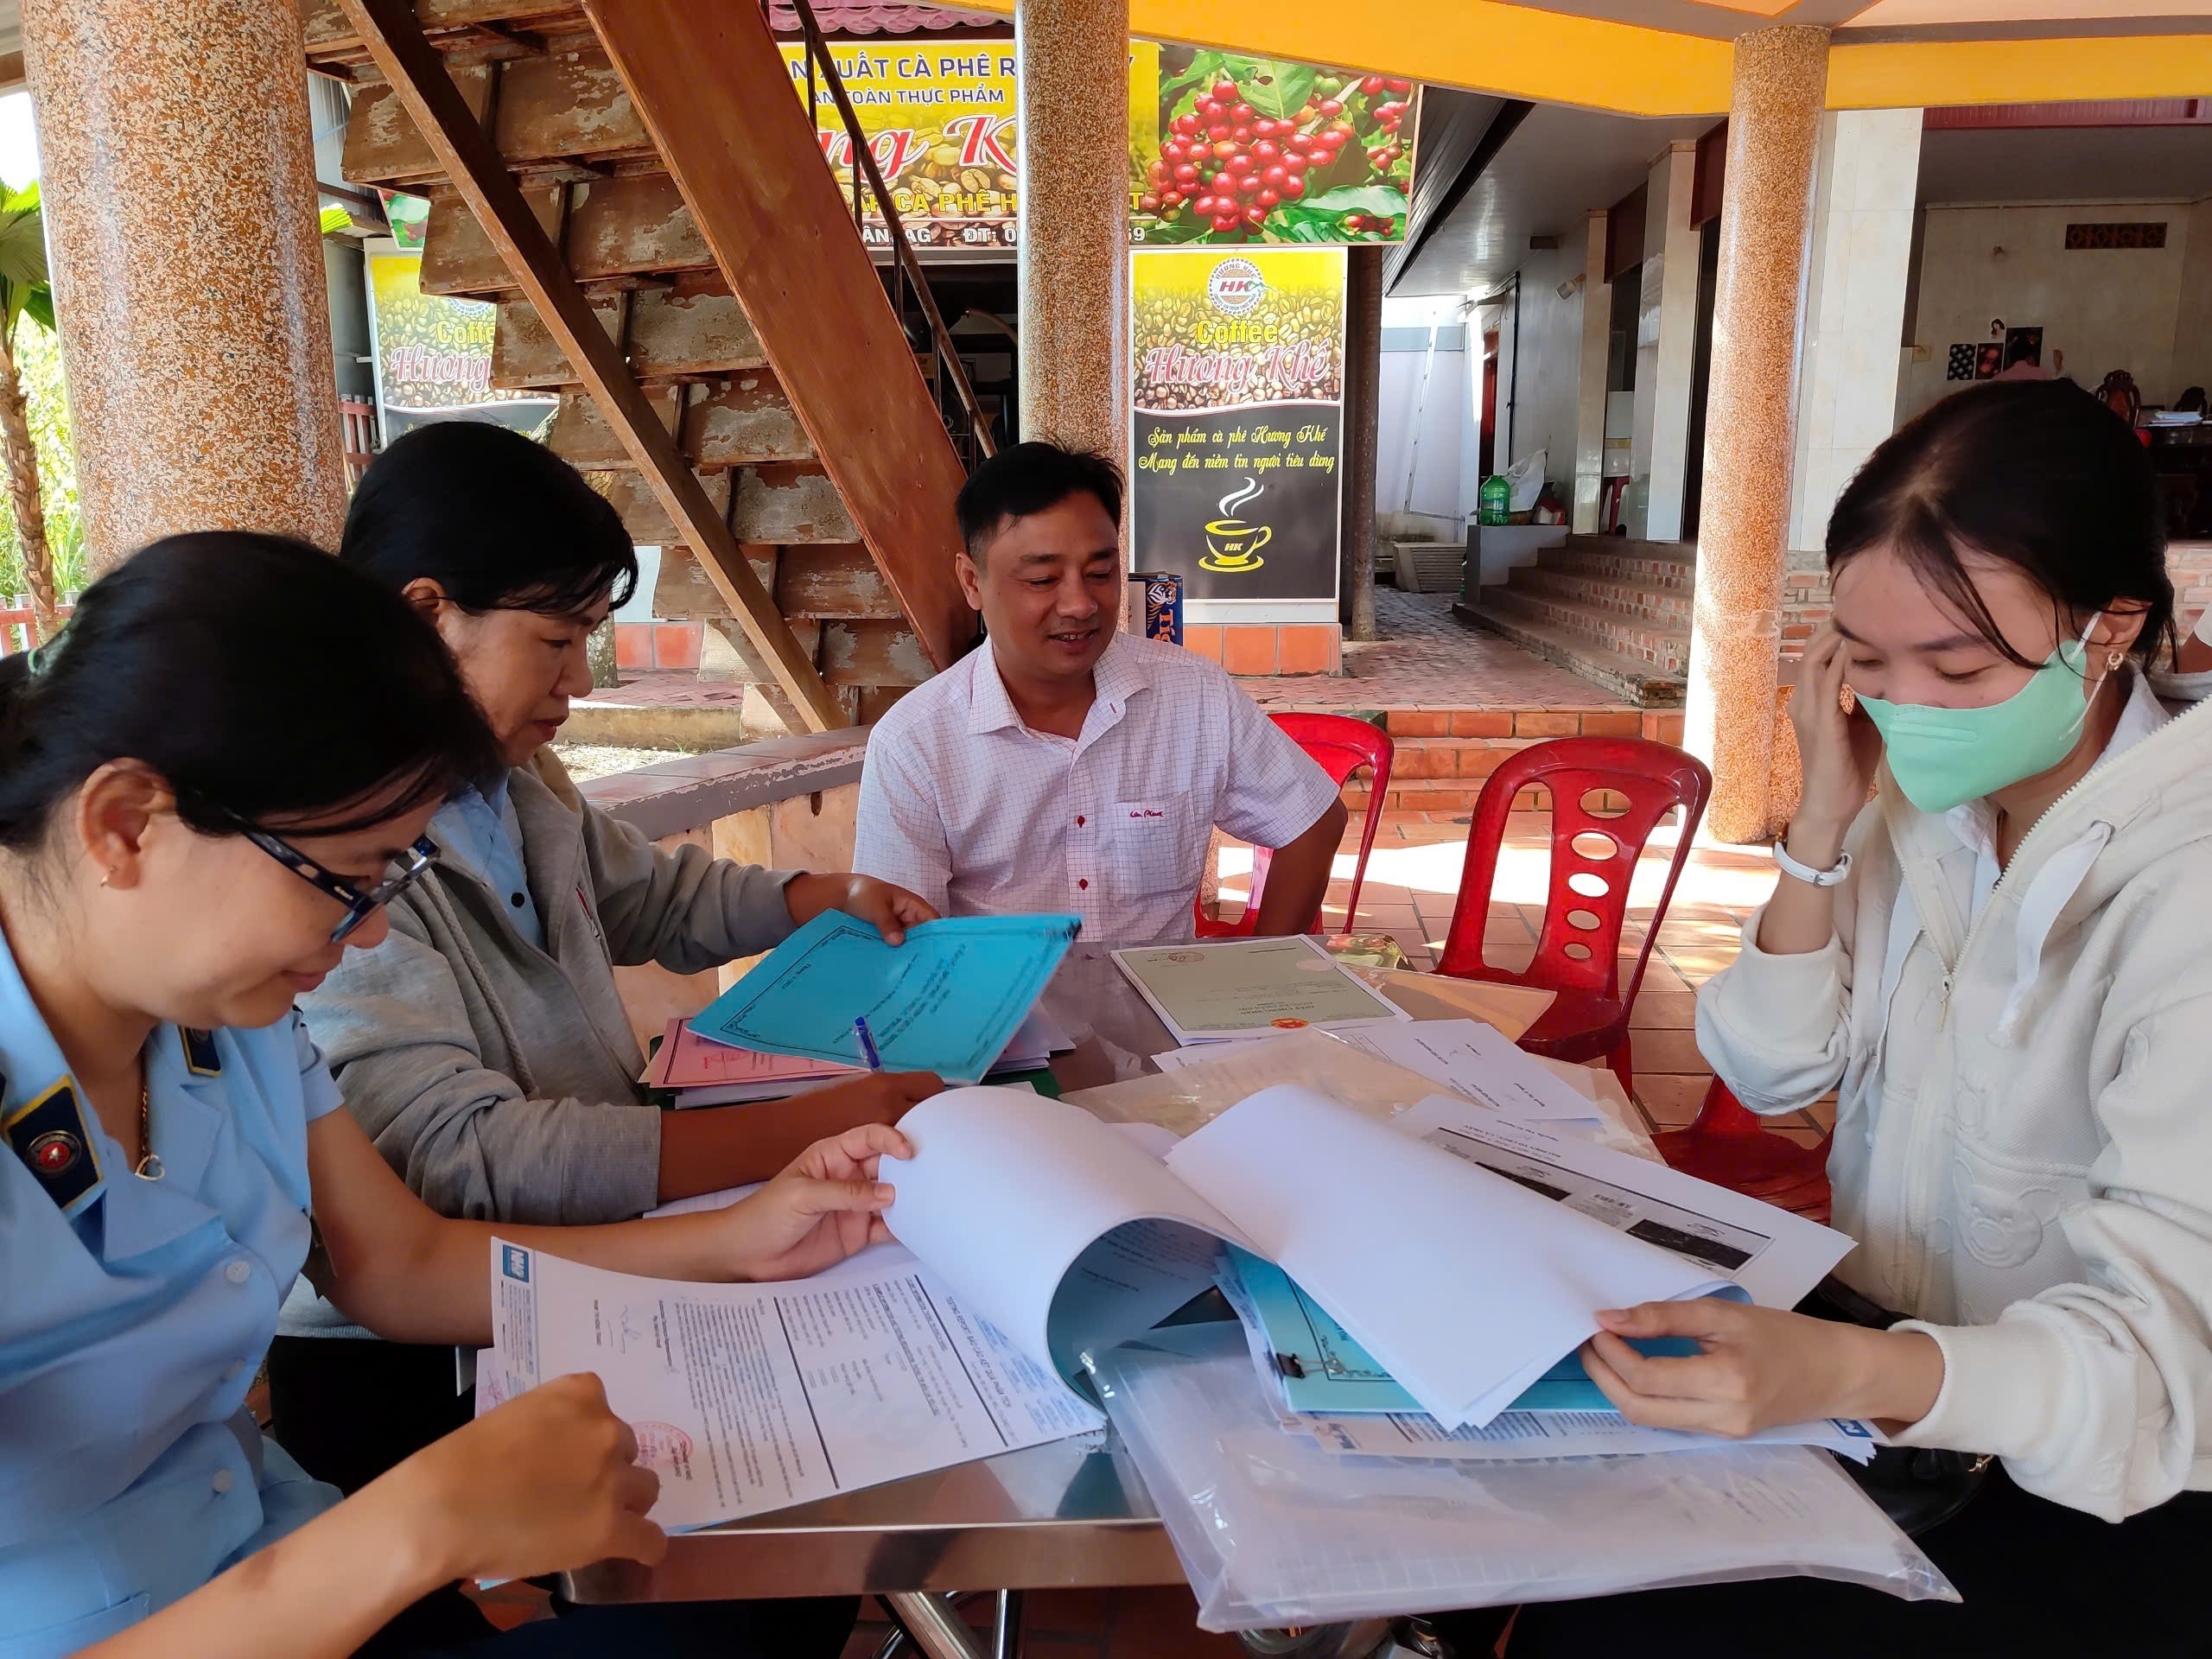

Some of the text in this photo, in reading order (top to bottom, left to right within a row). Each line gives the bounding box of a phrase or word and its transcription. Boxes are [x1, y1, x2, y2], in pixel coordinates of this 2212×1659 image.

[820, 51, 890, 79] UẤT
[898, 54, 931, 79] CÀ
[939, 54, 991, 78] PHÊ
[897, 88, 944, 105] THỰC
[950, 85, 1004, 103] PHẨM
[938, 189, 991, 212] PHÊ
[435, 320, 497, 344] Coffe
[1196, 319, 1279, 344] Coffee
[390, 342, 491, 394] Hương
[1145, 342, 1258, 393] Hương
[1147, 426, 1173, 448] Sản
[1176, 426, 1207, 449] phẩm
[1211, 429, 1224, 443] cà
[1226, 426, 1248, 448] phê
[1250, 425, 1292, 448] Hương
[1138, 451, 1178, 475] Mang
[1182, 451, 1200, 469] đến
[1234, 453, 1249, 468] tin
[1253, 452, 1281, 474] người
[1285, 452, 1305, 467] tiêu
[1308, 450, 1335, 474] dùng
[1224, 543, 1244, 551] HK
